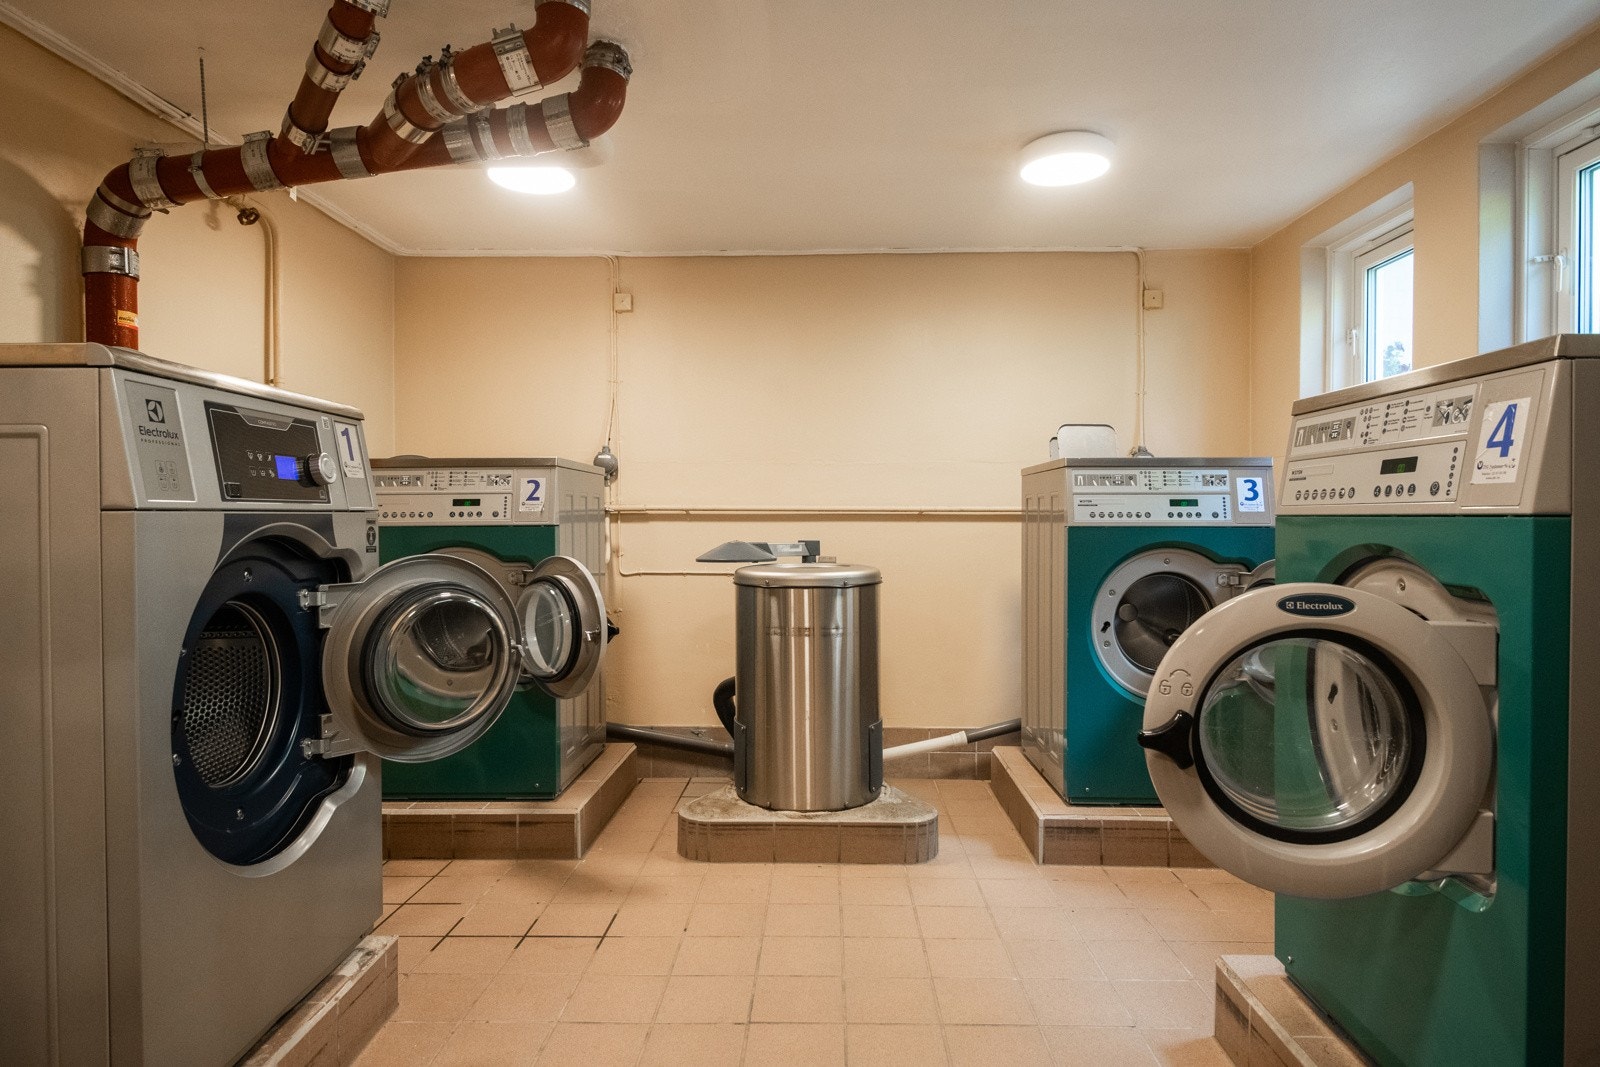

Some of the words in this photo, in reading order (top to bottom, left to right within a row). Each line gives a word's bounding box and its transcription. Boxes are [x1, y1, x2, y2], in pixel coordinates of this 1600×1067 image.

[138, 425, 179, 440] Electrolux
[1486, 403, 1517, 457] 4
[341, 427, 354, 461] 1
[526, 479, 541, 501] 2
[1243, 479, 1259, 501] 3
[1296, 601, 1343, 610] Electrolux
